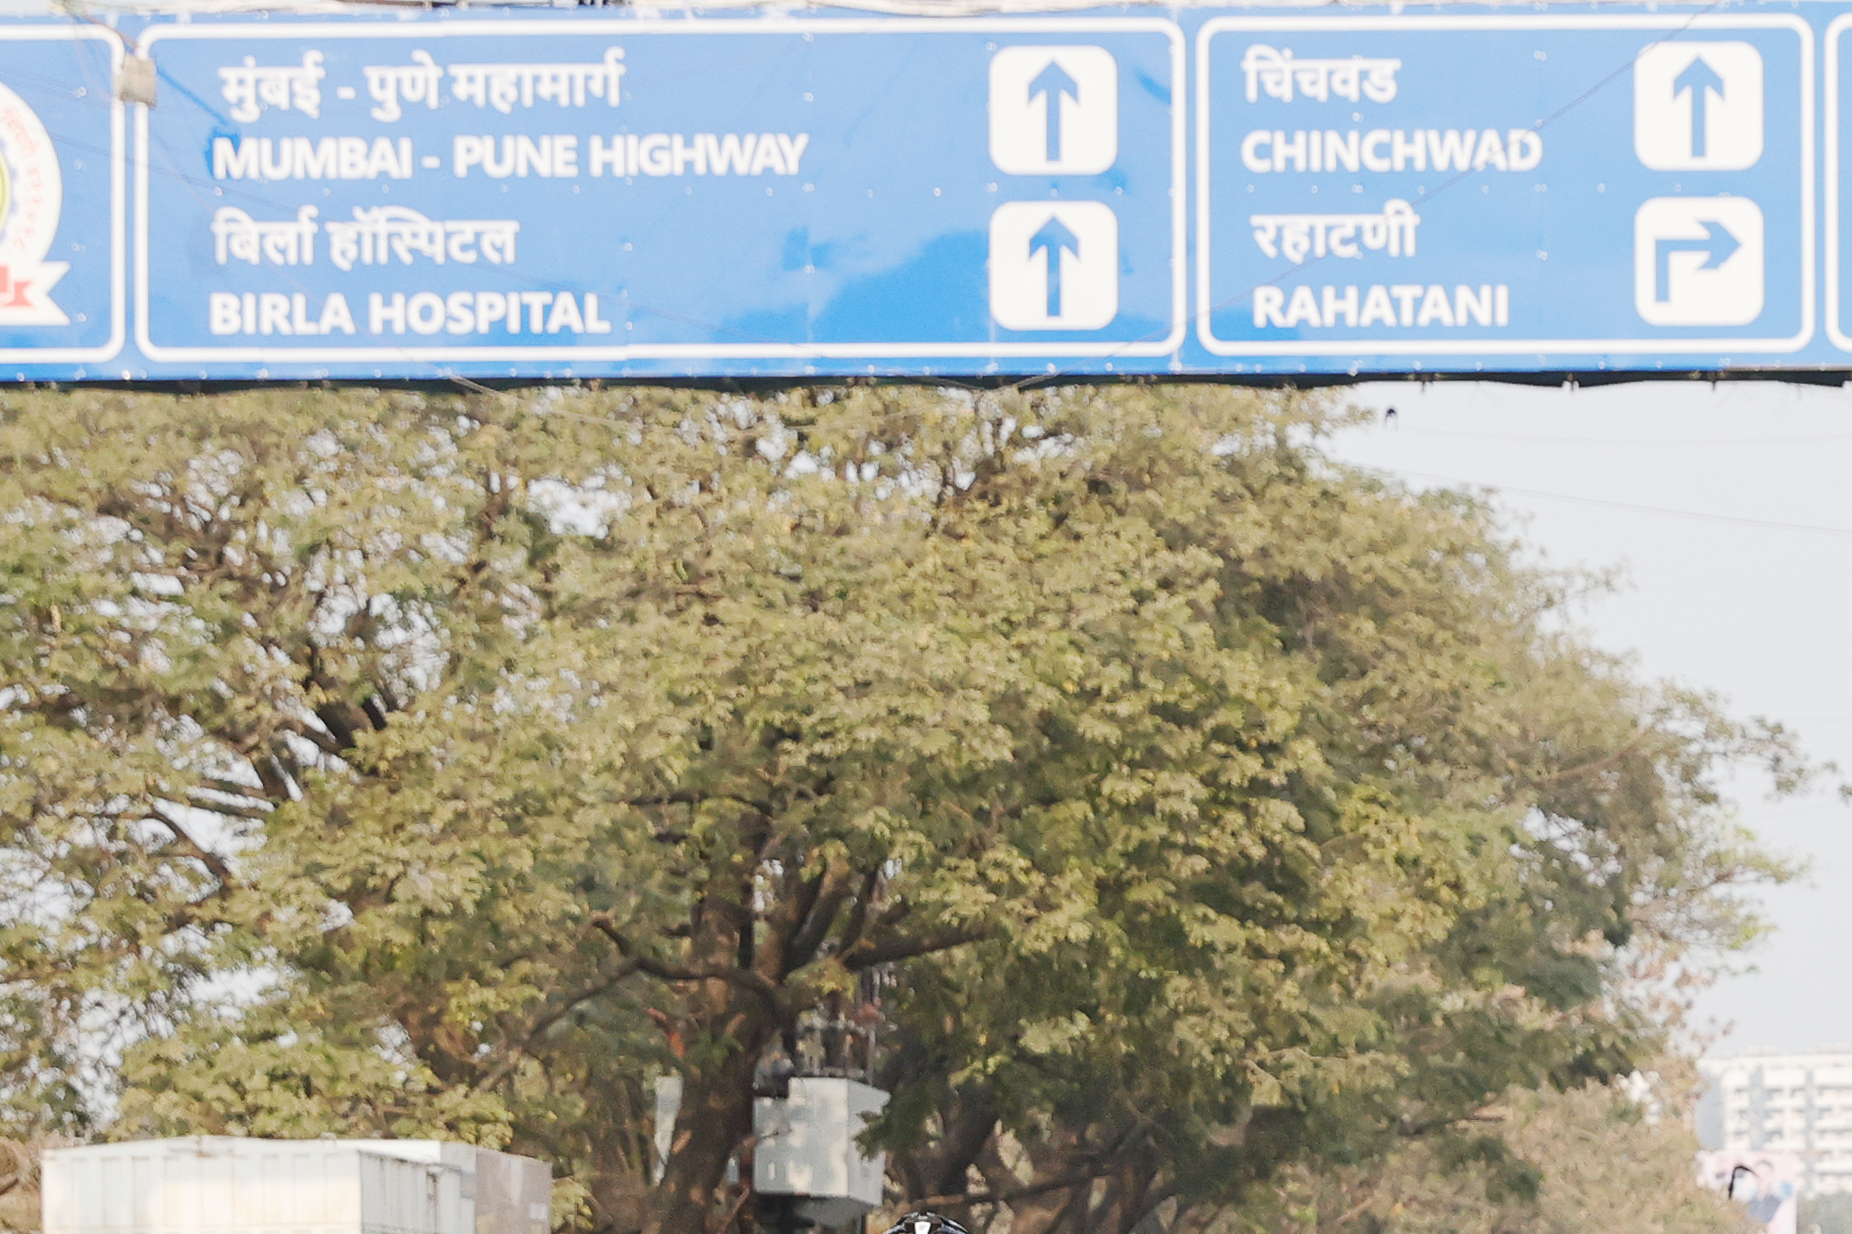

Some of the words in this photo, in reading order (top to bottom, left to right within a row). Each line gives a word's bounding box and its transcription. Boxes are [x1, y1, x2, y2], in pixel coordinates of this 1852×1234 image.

[219, 49, 325, 123] मुंबई
[364, 50, 443, 122] पुणे
[450, 46, 625, 113] महामार्ग
[1242, 44, 1402, 104] चिंचवड
[213, 136, 413, 181] MUMBAI
[453, 134, 579, 179] PUNE
[589, 133, 809, 178] HIGHWAY
[1241, 128, 1543, 174] CHINCHWAD
[325, 205, 521, 271] हॉस्पिटल
[1250, 199, 1420, 264] रहाटणी
[210, 292, 356, 336] BIRLA
[369, 291, 611, 335] HOSPITAL
[1253, 284, 1509, 328] RAHATANI
